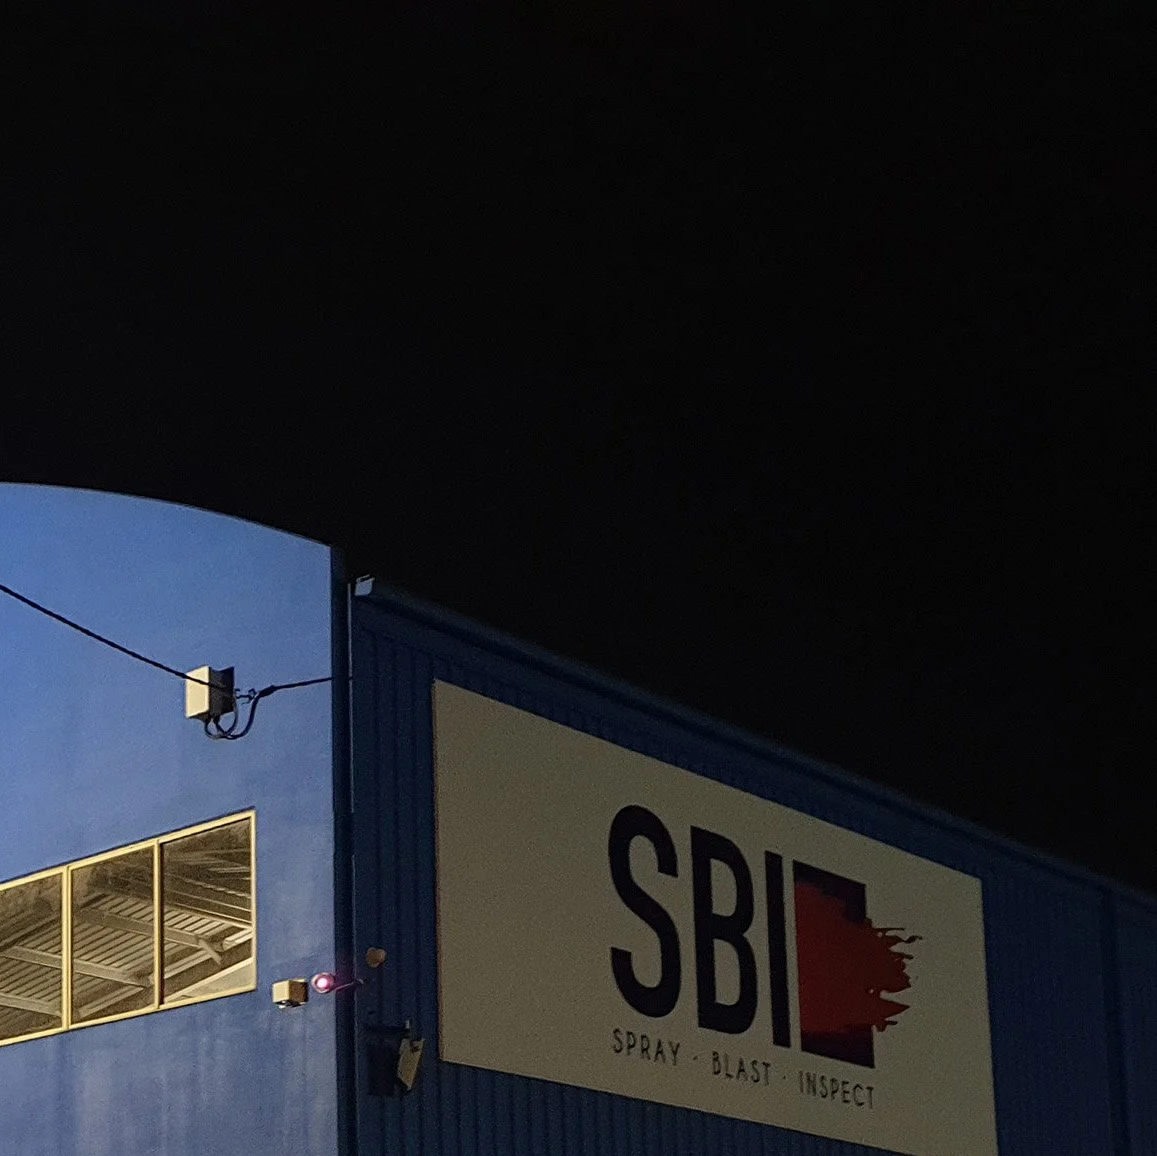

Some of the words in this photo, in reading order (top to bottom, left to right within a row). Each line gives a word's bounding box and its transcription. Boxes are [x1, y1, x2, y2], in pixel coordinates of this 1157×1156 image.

[608, 805, 791, 1048] SBI
[612, 1028, 682, 1067] SPRAY
[712, 1051, 772, 1086] BLAST
[799, 1070, 875, 1110] INSPECT
